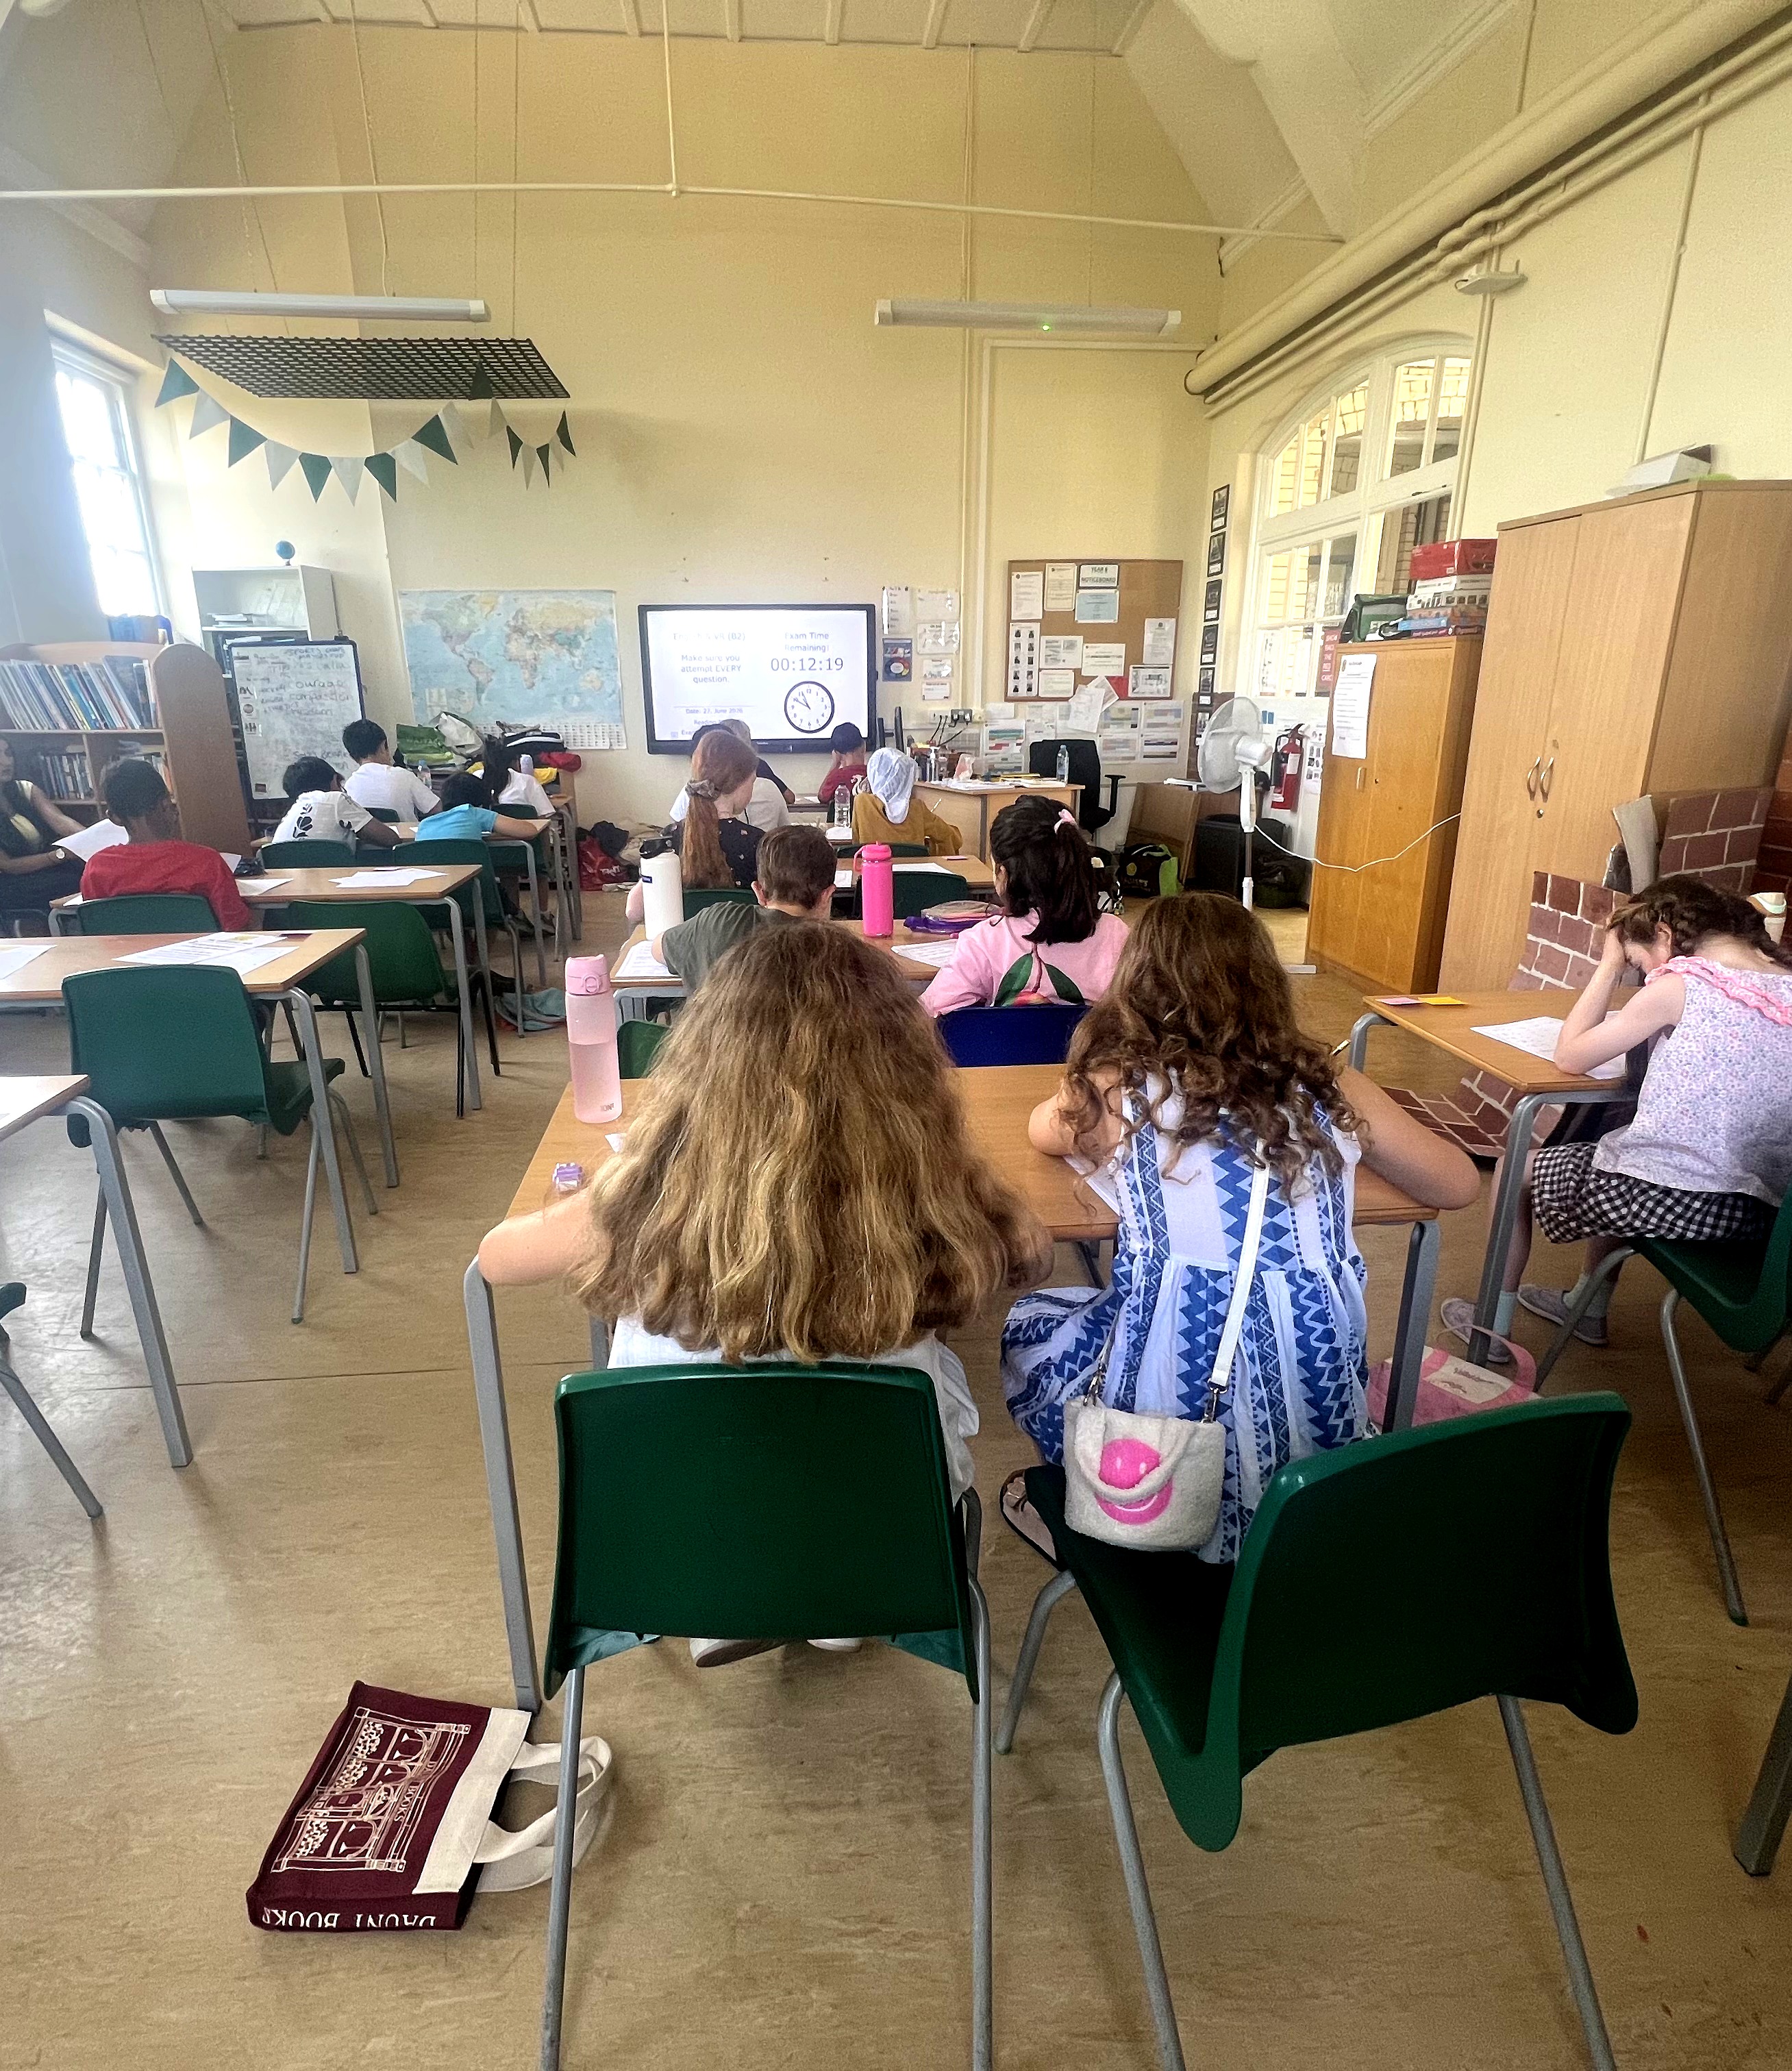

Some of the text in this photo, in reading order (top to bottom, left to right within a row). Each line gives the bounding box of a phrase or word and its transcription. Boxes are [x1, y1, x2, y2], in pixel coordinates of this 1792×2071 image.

[673, 632, 703, 641] Engh
[785, 632, 830, 640] Exam Time
[771, 657, 844, 671] 00:12:19
[681, 665, 713, 673] attempt
[693, 675, 730, 684] question.
[394, 1786, 417, 1822] BOOKS
